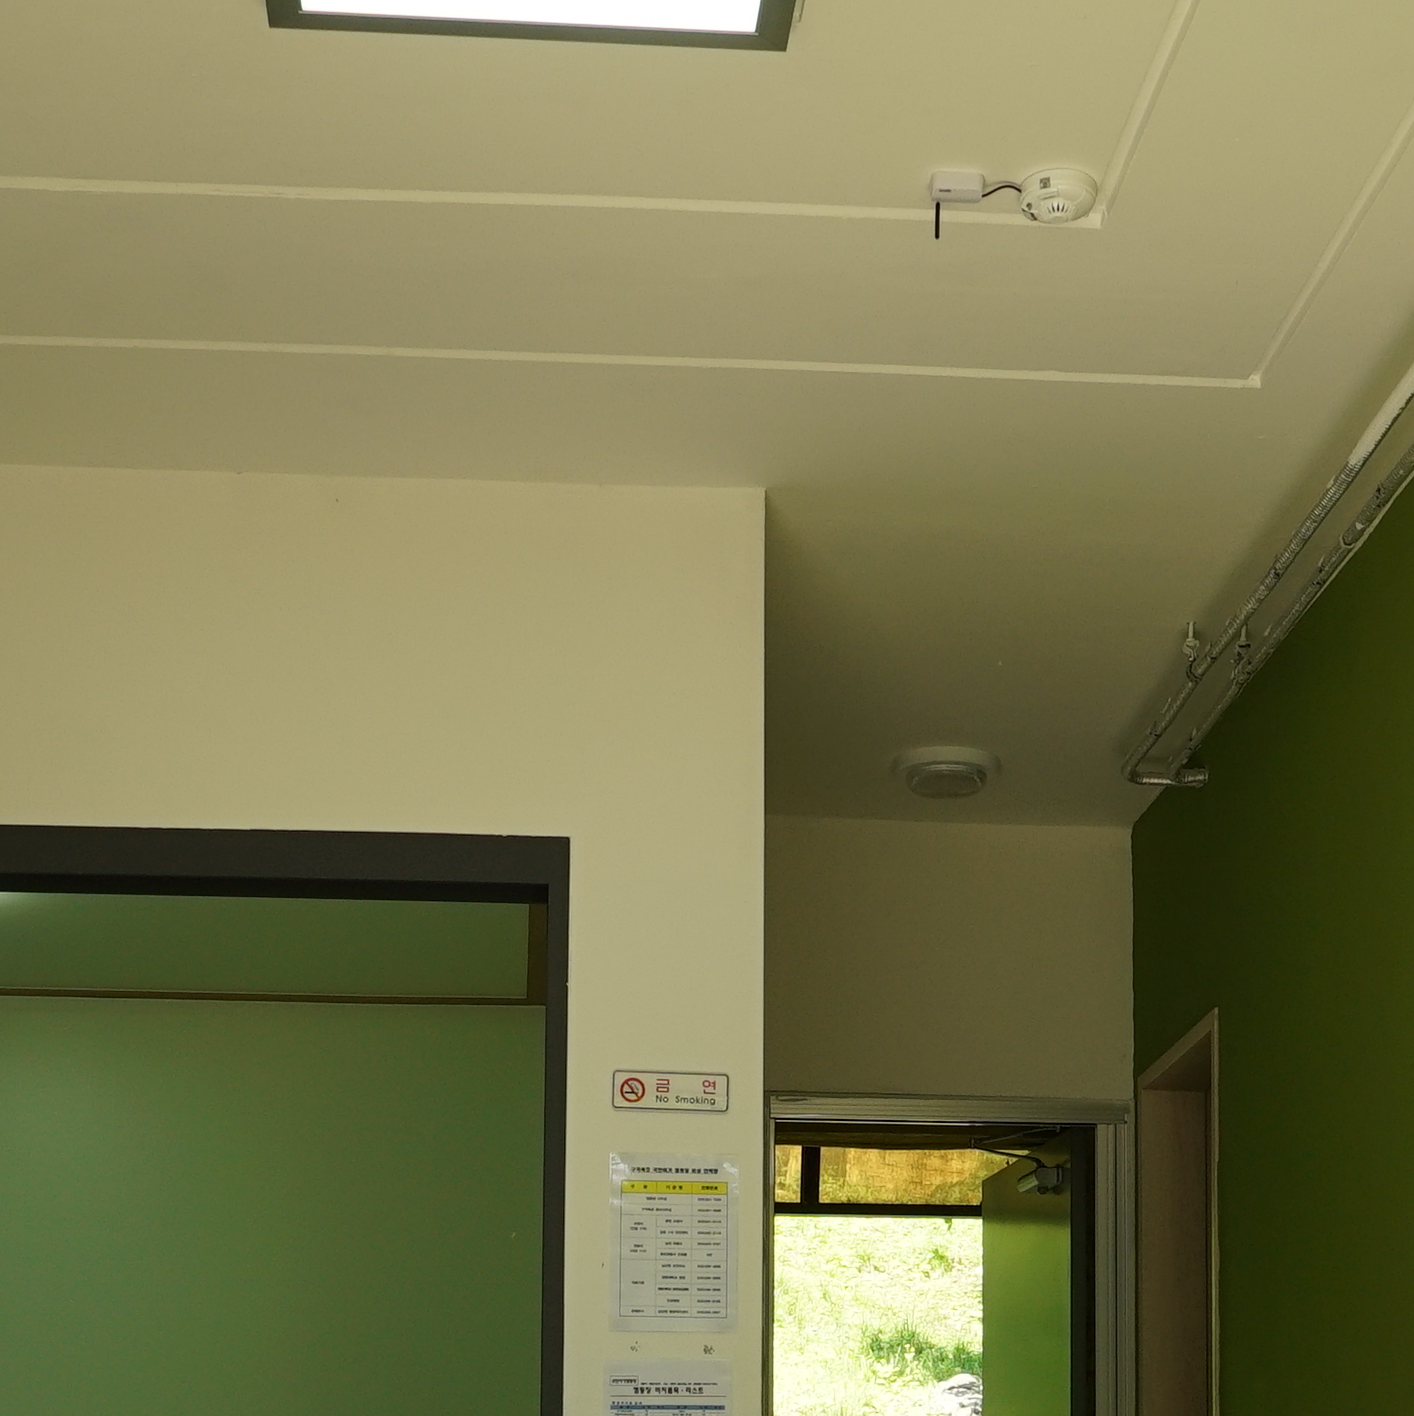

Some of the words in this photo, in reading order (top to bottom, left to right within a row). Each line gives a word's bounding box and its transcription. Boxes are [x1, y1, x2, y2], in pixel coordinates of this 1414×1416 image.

[655, 1078, 670, 1093] 금
[702, 1079, 717, 1095] 연
[655, 1095, 669, 1103] No
[675, 1095, 716, 1106] Smoking
